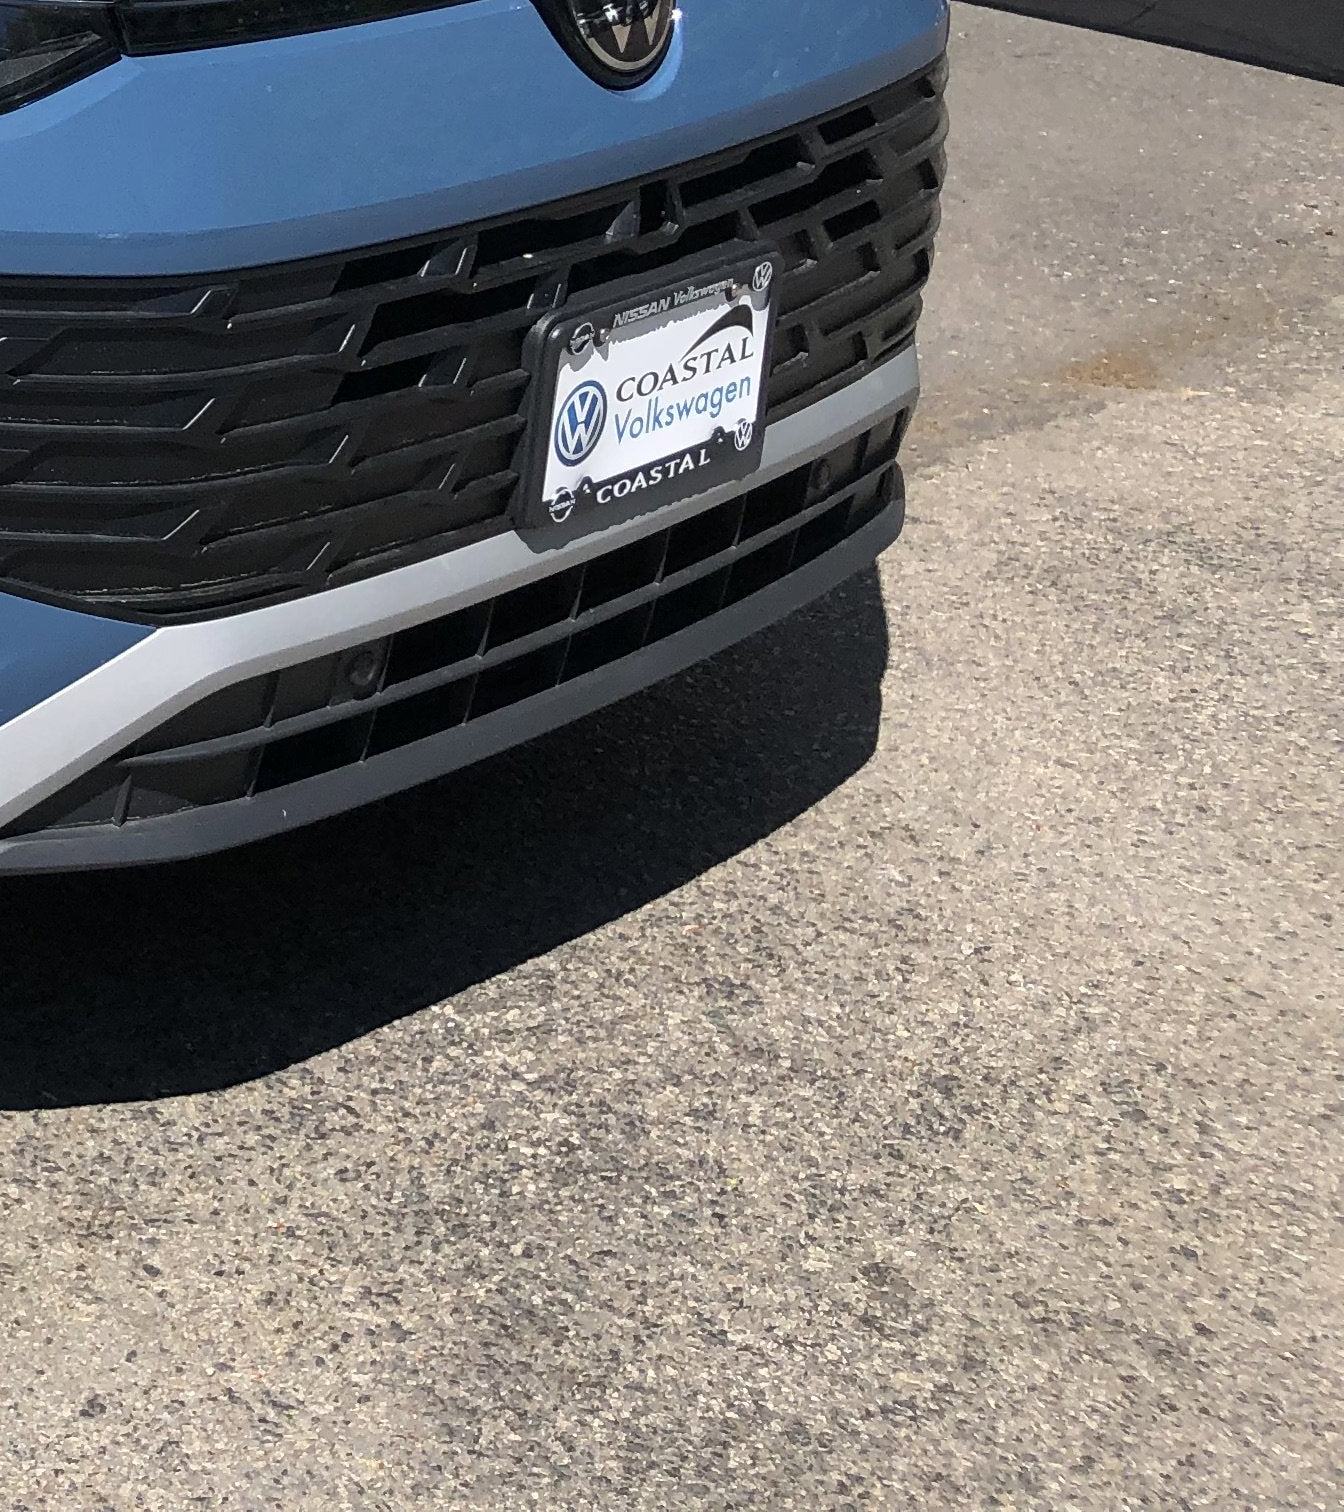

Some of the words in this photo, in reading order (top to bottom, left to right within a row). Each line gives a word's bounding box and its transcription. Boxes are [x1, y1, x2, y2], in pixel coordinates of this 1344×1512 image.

[612, 296, 671, 329] NISSAN
[673, 277, 734, 307] Volkswagen
[616, 336, 754, 404] COASTAL
[614, 375, 751, 445] Volkswagen
[595, 452, 711, 505] COASTAL
